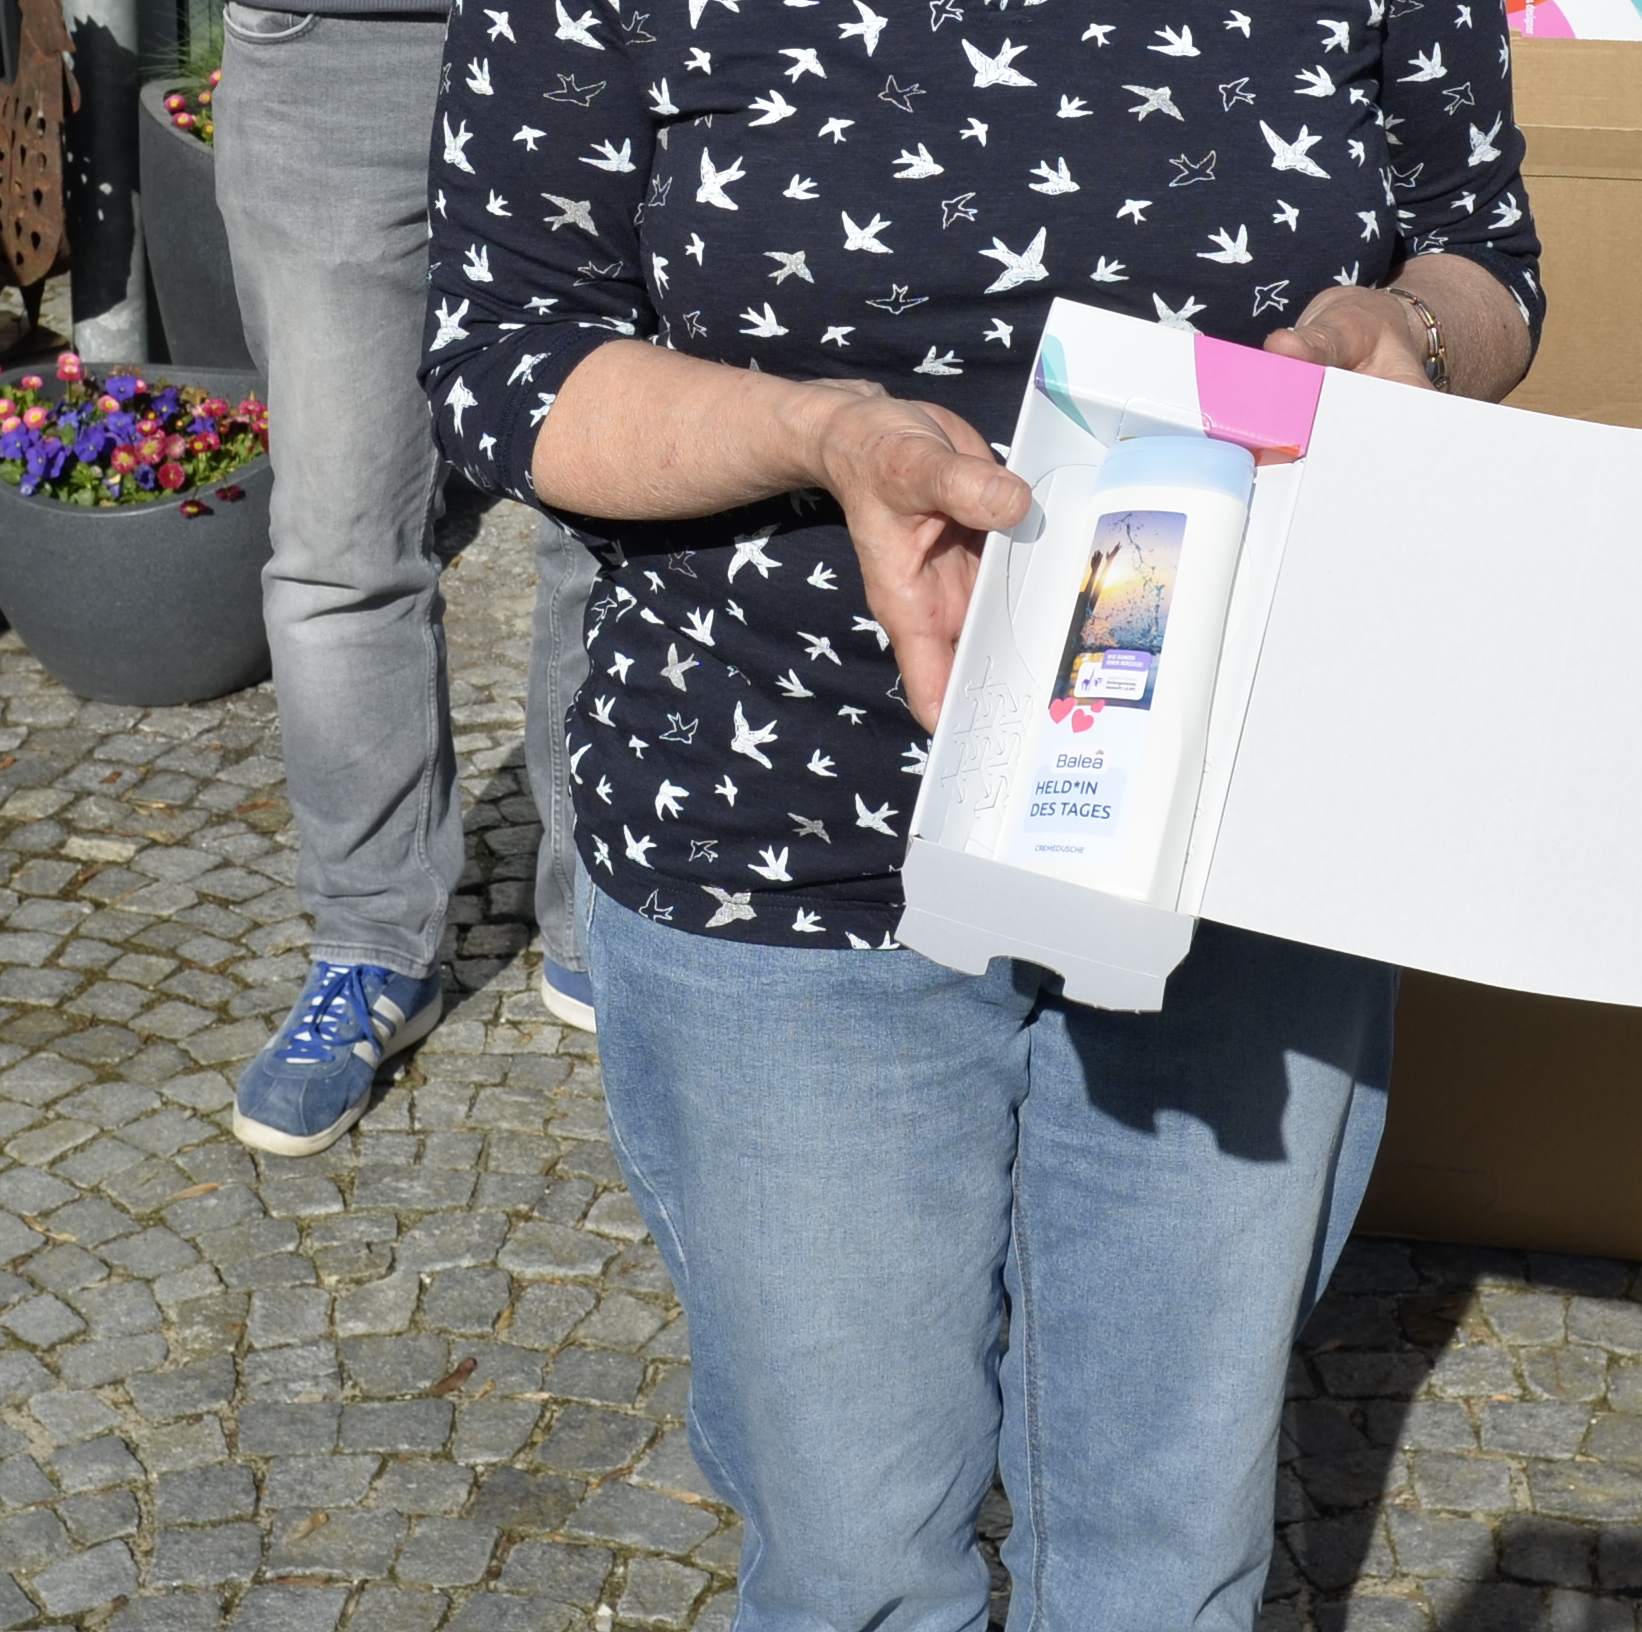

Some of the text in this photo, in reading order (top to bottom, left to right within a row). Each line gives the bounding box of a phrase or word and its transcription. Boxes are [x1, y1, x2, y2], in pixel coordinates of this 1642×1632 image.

[1055, 753, 1104, 770] Balea
[1029, 802, 1112, 820] DES TAGES
